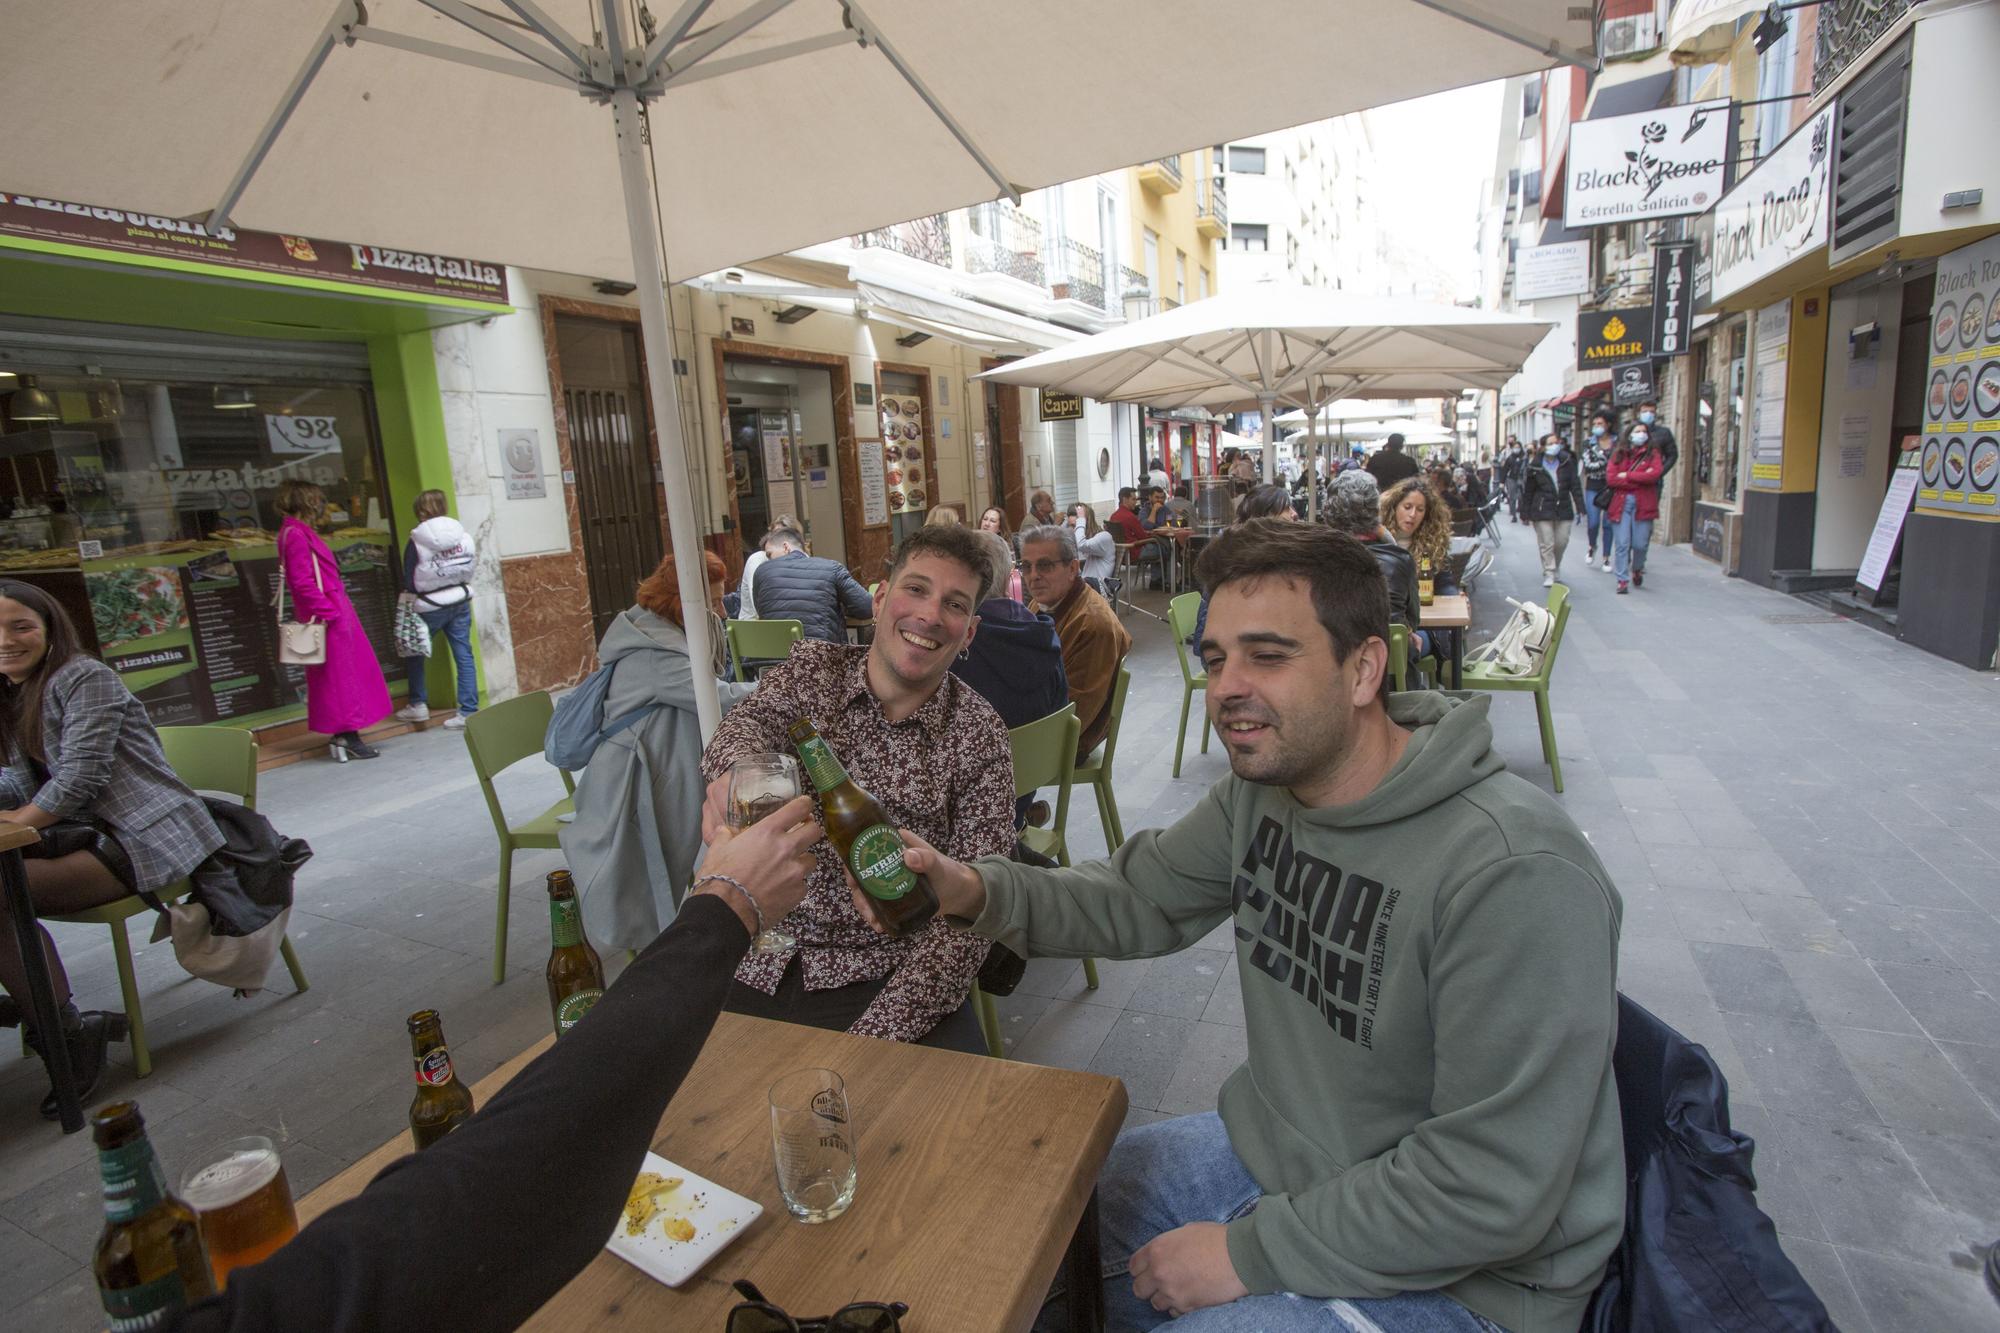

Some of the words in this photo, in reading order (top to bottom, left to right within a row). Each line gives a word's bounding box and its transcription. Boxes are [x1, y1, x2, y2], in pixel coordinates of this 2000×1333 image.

[1575, 164, 1639, 192] Black
[1655, 159, 1717, 181] Rose
[1580, 201, 1634, 218] Estrella
[1637, 195, 1690, 211] Galicia
[1714, 201, 1756, 279] Black
[1760, 176, 1810, 249] Rose
[350, 244, 501, 286] pizzatalia
[1937, 264, 1976, 296] Black
[1662, 249, 1683, 352] TATTOO
[1584, 342, 1643, 359] AMBER
[1044, 396, 1080, 415] Capri
[135, 460, 339, 492] izzatalia
[115, 650, 184, 671] pizzatalia
[859, 847, 905, 880] ESTRELL
[1380, 888, 1401, 927] SINCE
[1368, 922, 1390, 977] NINETEEN
[1364, 976, 1382, 1017] FORTY
[1360, 1017, 1374, 1051] EIGHT
